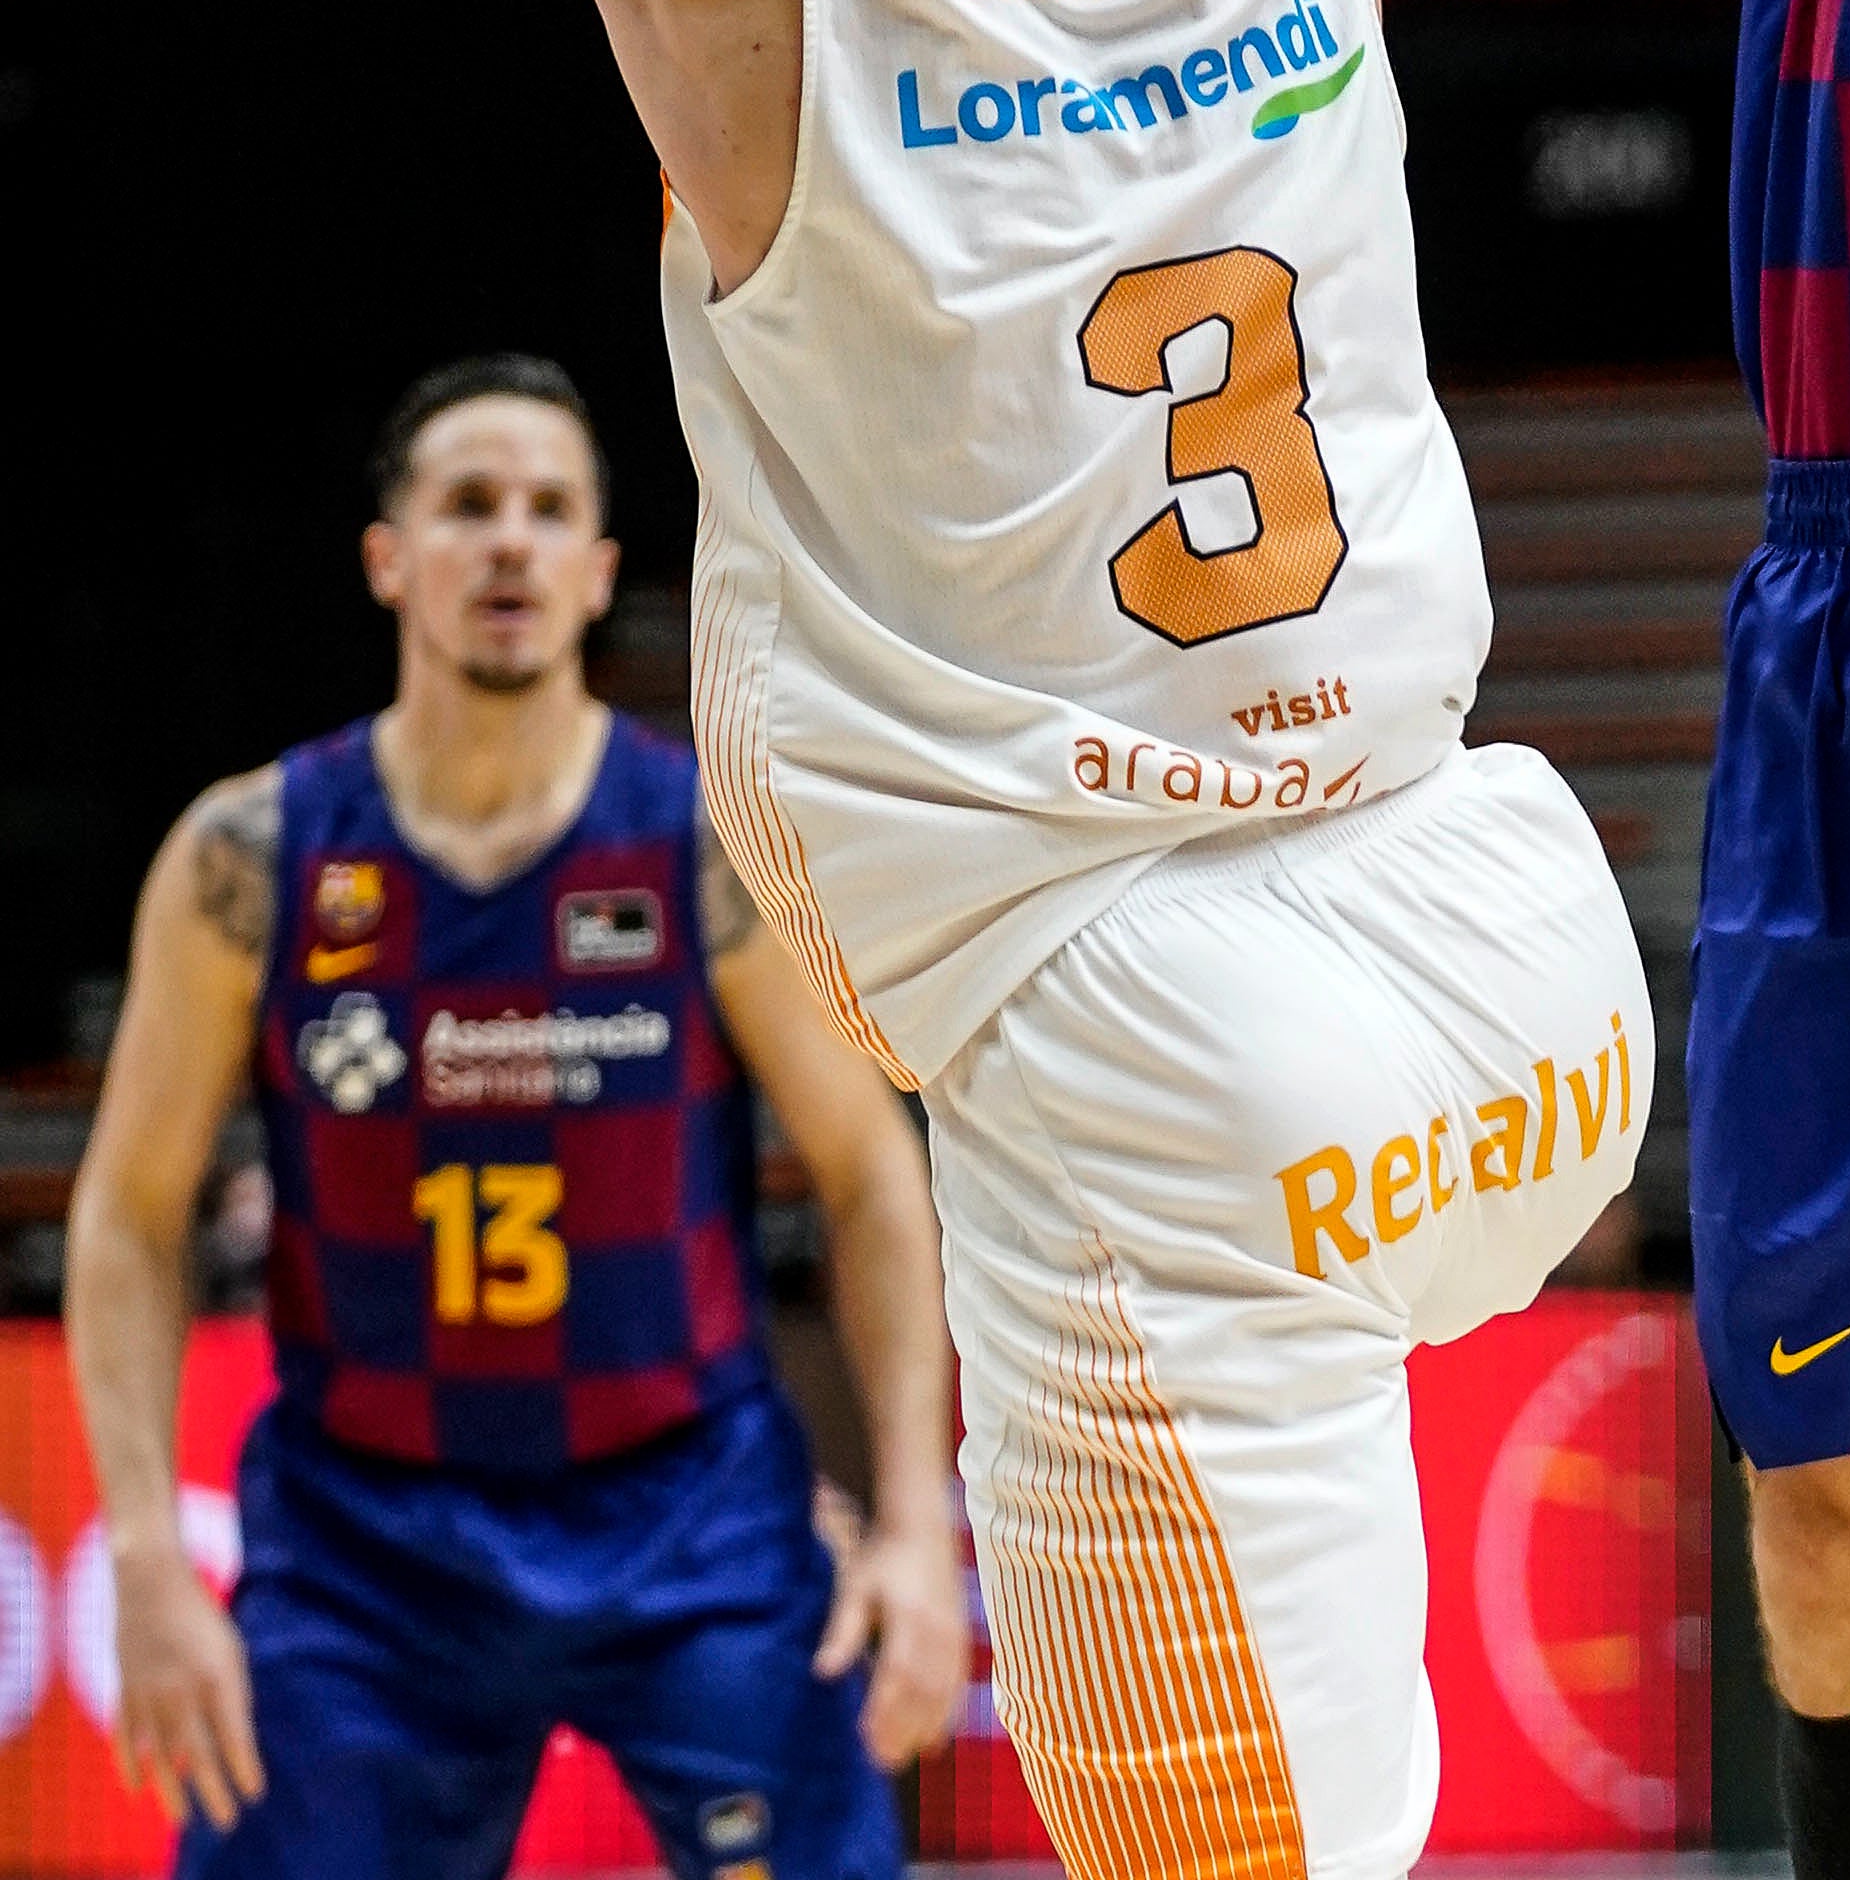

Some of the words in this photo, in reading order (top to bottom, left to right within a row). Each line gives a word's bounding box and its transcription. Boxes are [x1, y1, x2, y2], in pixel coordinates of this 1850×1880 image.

[1076, 245, 1349, 649] 3
[1231, 674, 1351, 737] visit
[411, 1162, 569, 1327] 13
[1272, 1009, 1632, 1280] Recalvi
